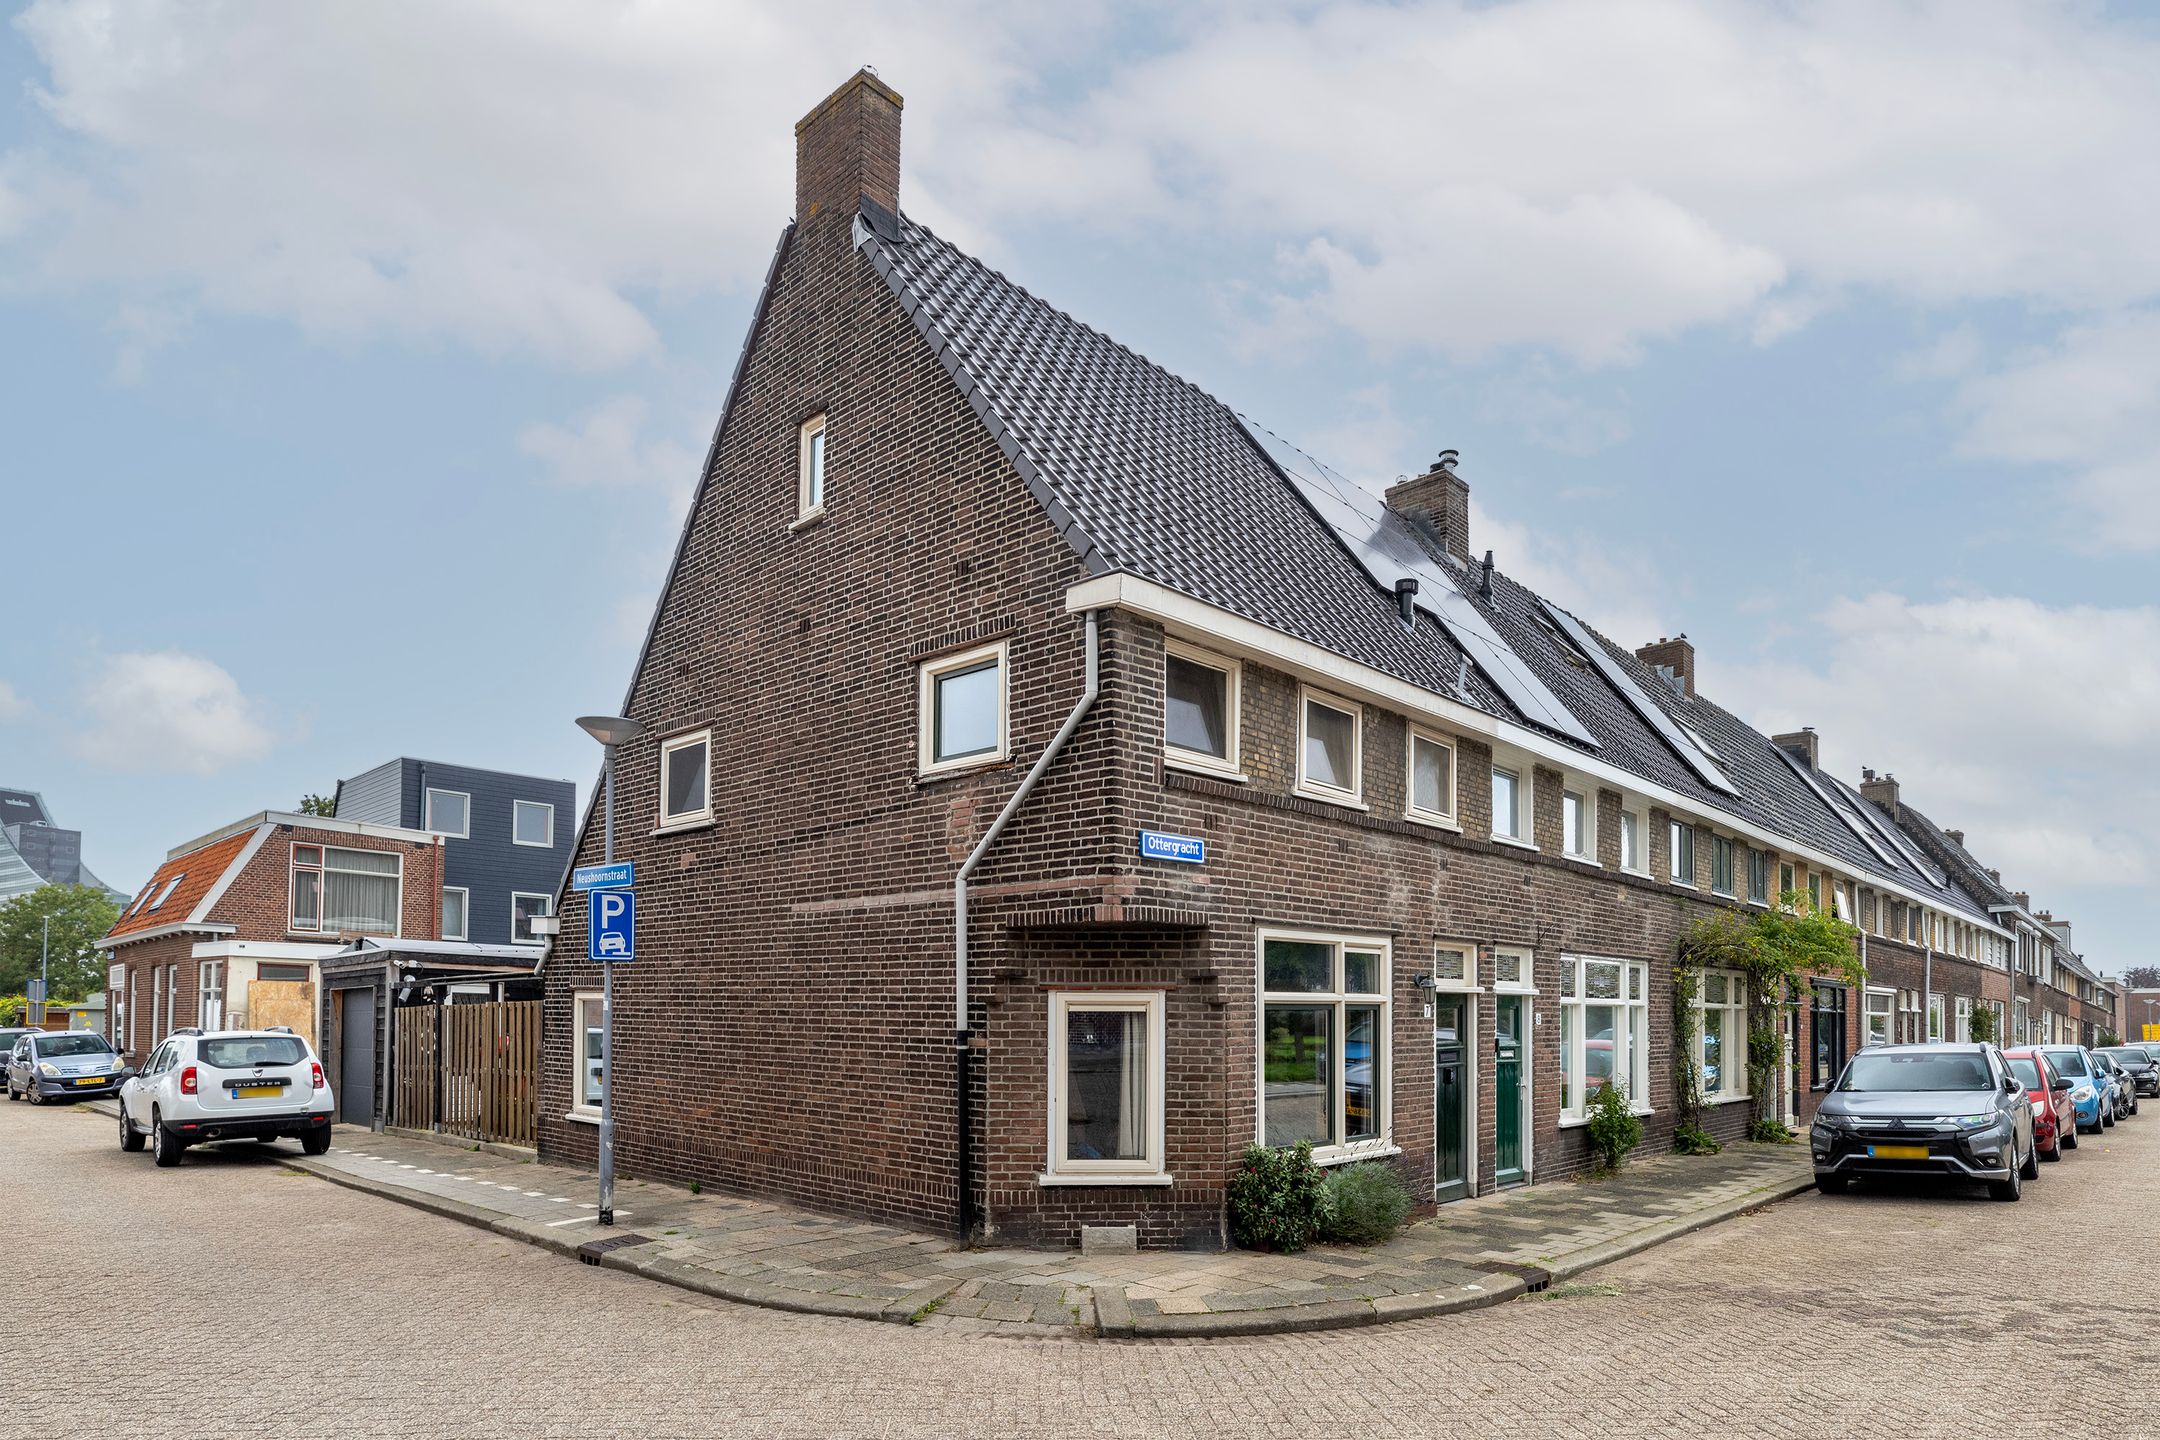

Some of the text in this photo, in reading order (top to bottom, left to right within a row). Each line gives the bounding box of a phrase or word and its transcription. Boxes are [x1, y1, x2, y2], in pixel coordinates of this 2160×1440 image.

[1148, 836, 1200, 856] Ottergracht
[576, 869, 627, 884] Neushoornstraat
[601, 894, 625, 929] P
